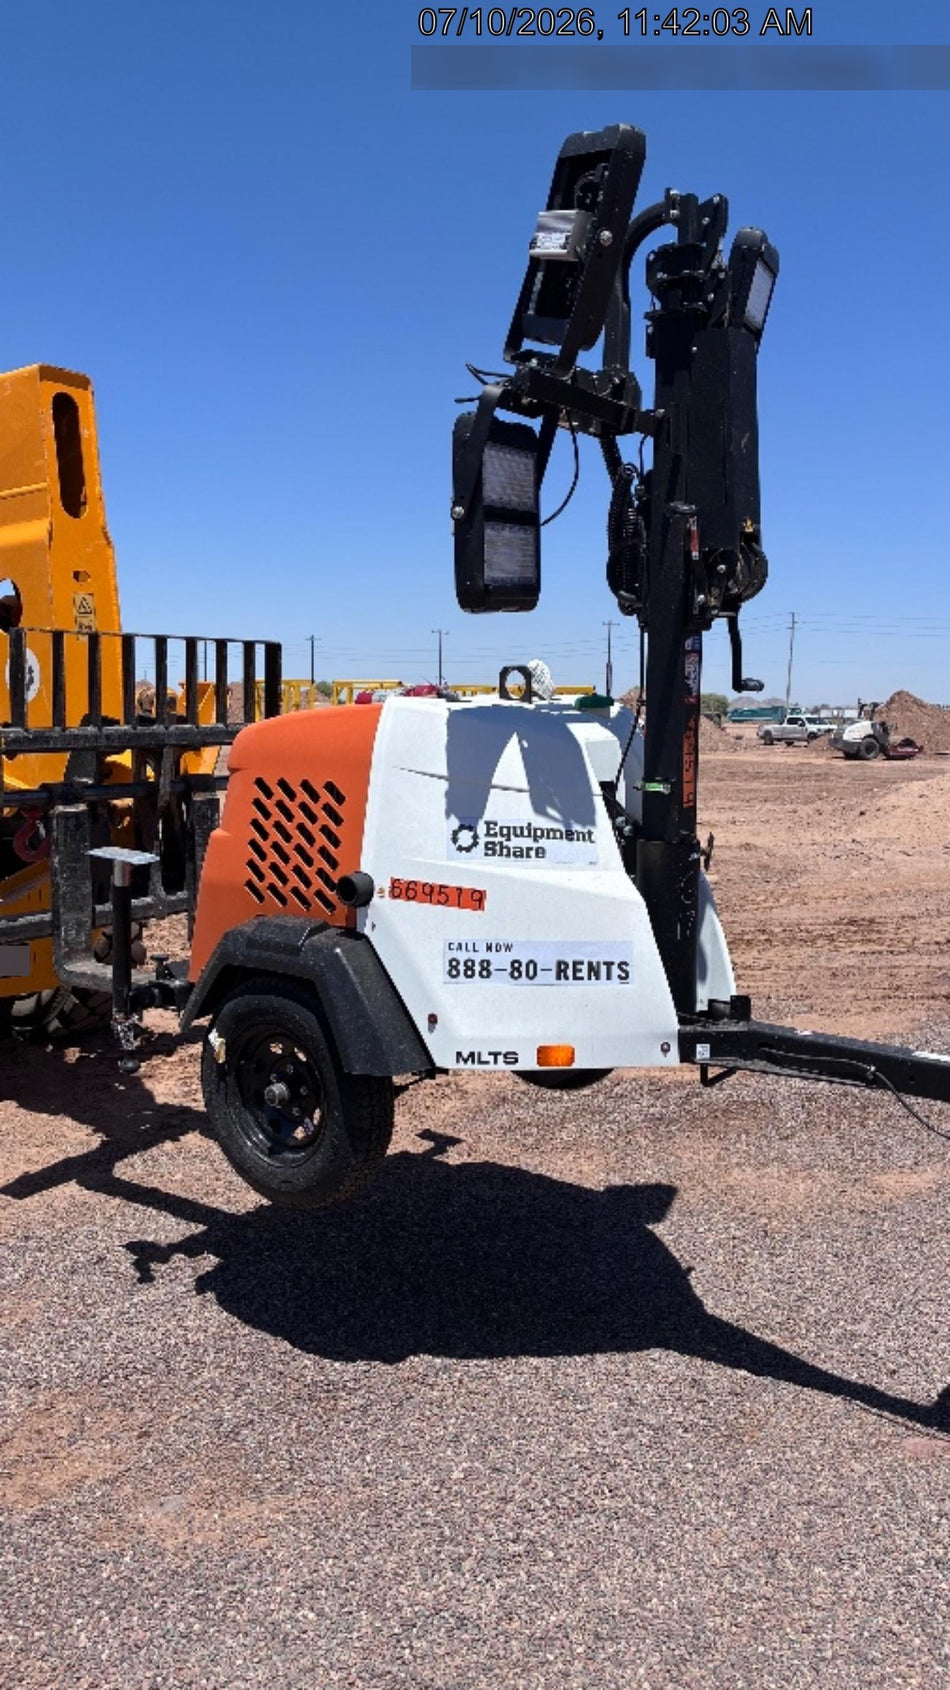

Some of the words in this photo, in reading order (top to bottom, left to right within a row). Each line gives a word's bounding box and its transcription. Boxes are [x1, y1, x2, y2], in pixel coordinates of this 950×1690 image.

[484, 820, 596, 843] Equipment
[484, 841, 547, 859] Share
[391, 877, 484, 910] 669519
[448, 942, 479, 953] CALL
[486, 942, 514, 953] NOW
[447, 957, 630, 981] 888-80-RENTS
[456, 1051, 519, 1065] MLTS
